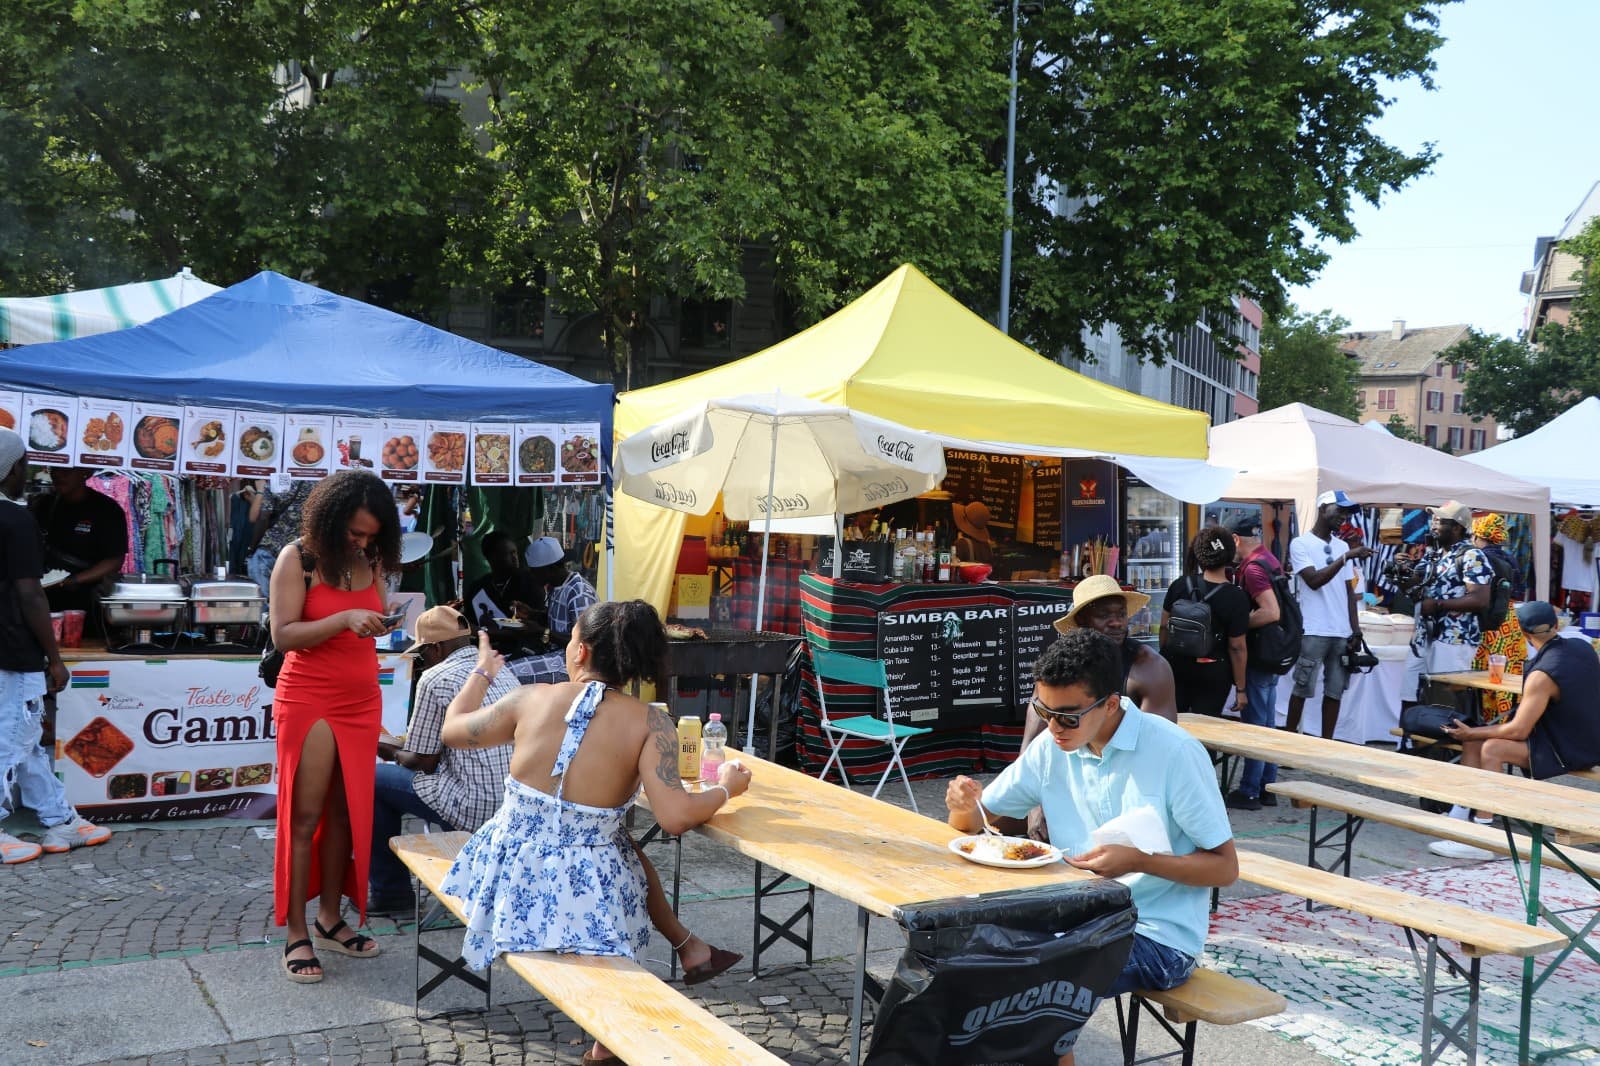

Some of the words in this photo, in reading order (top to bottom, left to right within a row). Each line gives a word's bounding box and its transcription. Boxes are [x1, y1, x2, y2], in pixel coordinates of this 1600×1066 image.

[877, 434, 915, 462] Coca-Cola
[947, 451, 988, 464] SIMBA
[991, 455, 1020, 465] BAR
[1036, 467, 1062, 477] SIM
[883, 611, 960, 625] SIMBA
[964, 608, 1008, 620] BAR
[910, 633, 923, 641] Sour
[883, 646, 899, 654] Cuba
[900, 645, 914, 653] Libre
[952, 666, 971, 675] Tequila
[975, 665, 988, 673] Shot
[186, 687, 233, 706] Taste
[236, 685, 259, 711] of
[882, 710, 911, 719] SECIAL:
[143, 703, 277, 747] Gamb
[682, 744, 697, 753] BIER
[167, 798, 252, 818] Gambia!!!
